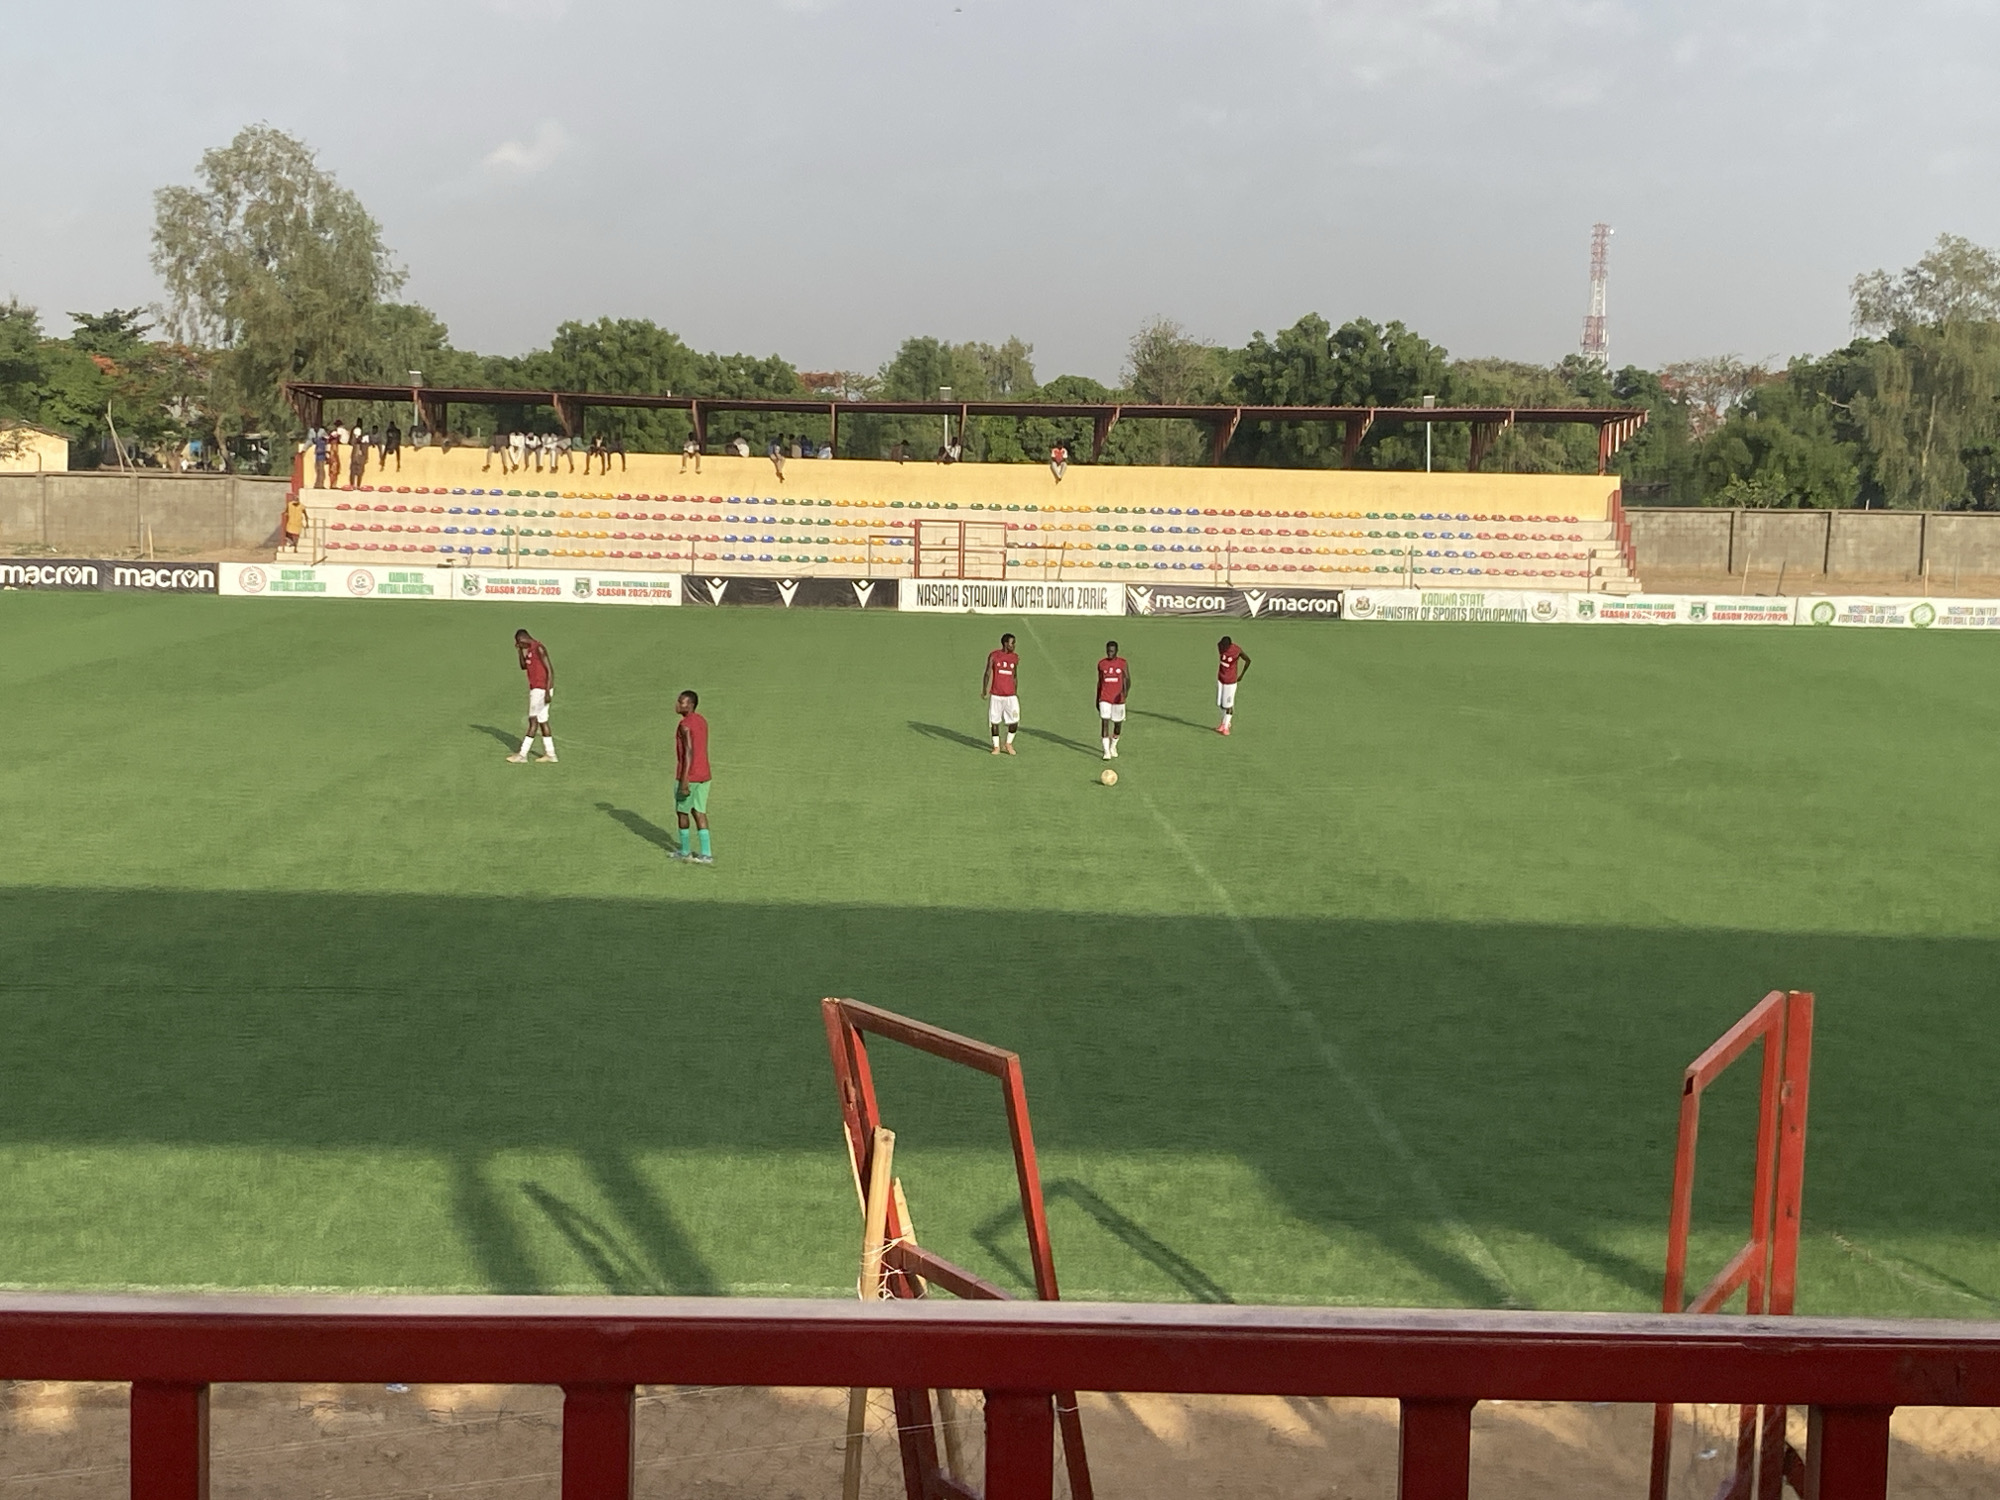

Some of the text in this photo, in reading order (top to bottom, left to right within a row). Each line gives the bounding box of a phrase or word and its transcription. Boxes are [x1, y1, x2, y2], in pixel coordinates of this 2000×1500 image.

[0, 565, 98, 585] macron
[114, 567, 214, 588] macron
[485, 585, 561, 595] SEASON 2025/2026
[597, 588, 672, 598] SEASON 2025/2026
[917, 584, 958, 607] NASARA
[962, 584, 1008, 607] STADIUM
[1012, 586, 1043, 607] KOFAR
[1047, 587, 1073, 609] DOKA
[1155, 594, 1225, 610] macron
[1268, 597, 1337, 613] macron
[1421, 592, 1485, 607] KADUNA STATE
[1421, 606, 1431, 620] OF
[1433, 607, 1467, 621] SPORTS
[1469, 607, 1528, 622] DEVELOPMENT
[1600, 610, 1630, 619] SEASON
[1712, 612, 1742, 621] SEASON
